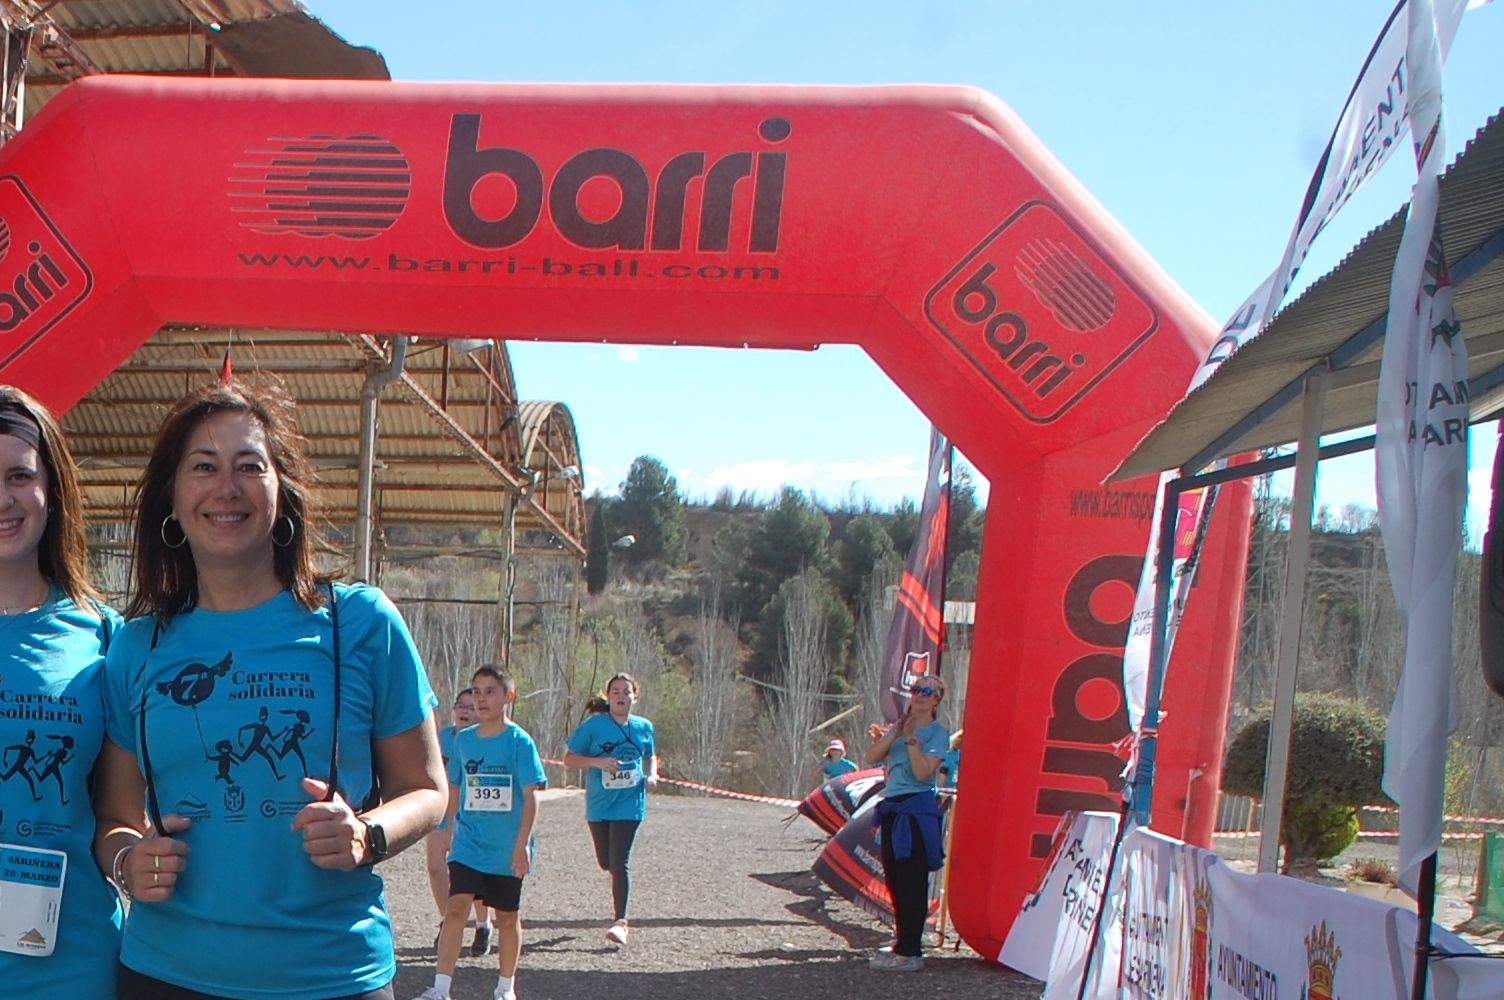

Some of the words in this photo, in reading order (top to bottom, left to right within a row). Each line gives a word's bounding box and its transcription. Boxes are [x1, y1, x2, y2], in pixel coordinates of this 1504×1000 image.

[442, 112, 792, 253] barri
[237, 251, 782, 281] www.barri-ball.com
[951, 261, 1086, 400] barri
[232, 670, 311, 686] Carrera
[0, 689, 80, 708] Carrera
[227, 683, 317, 701] solidaria
[474, 788, 501, 800] 393
[21, 872, 59, 883] MARZO
